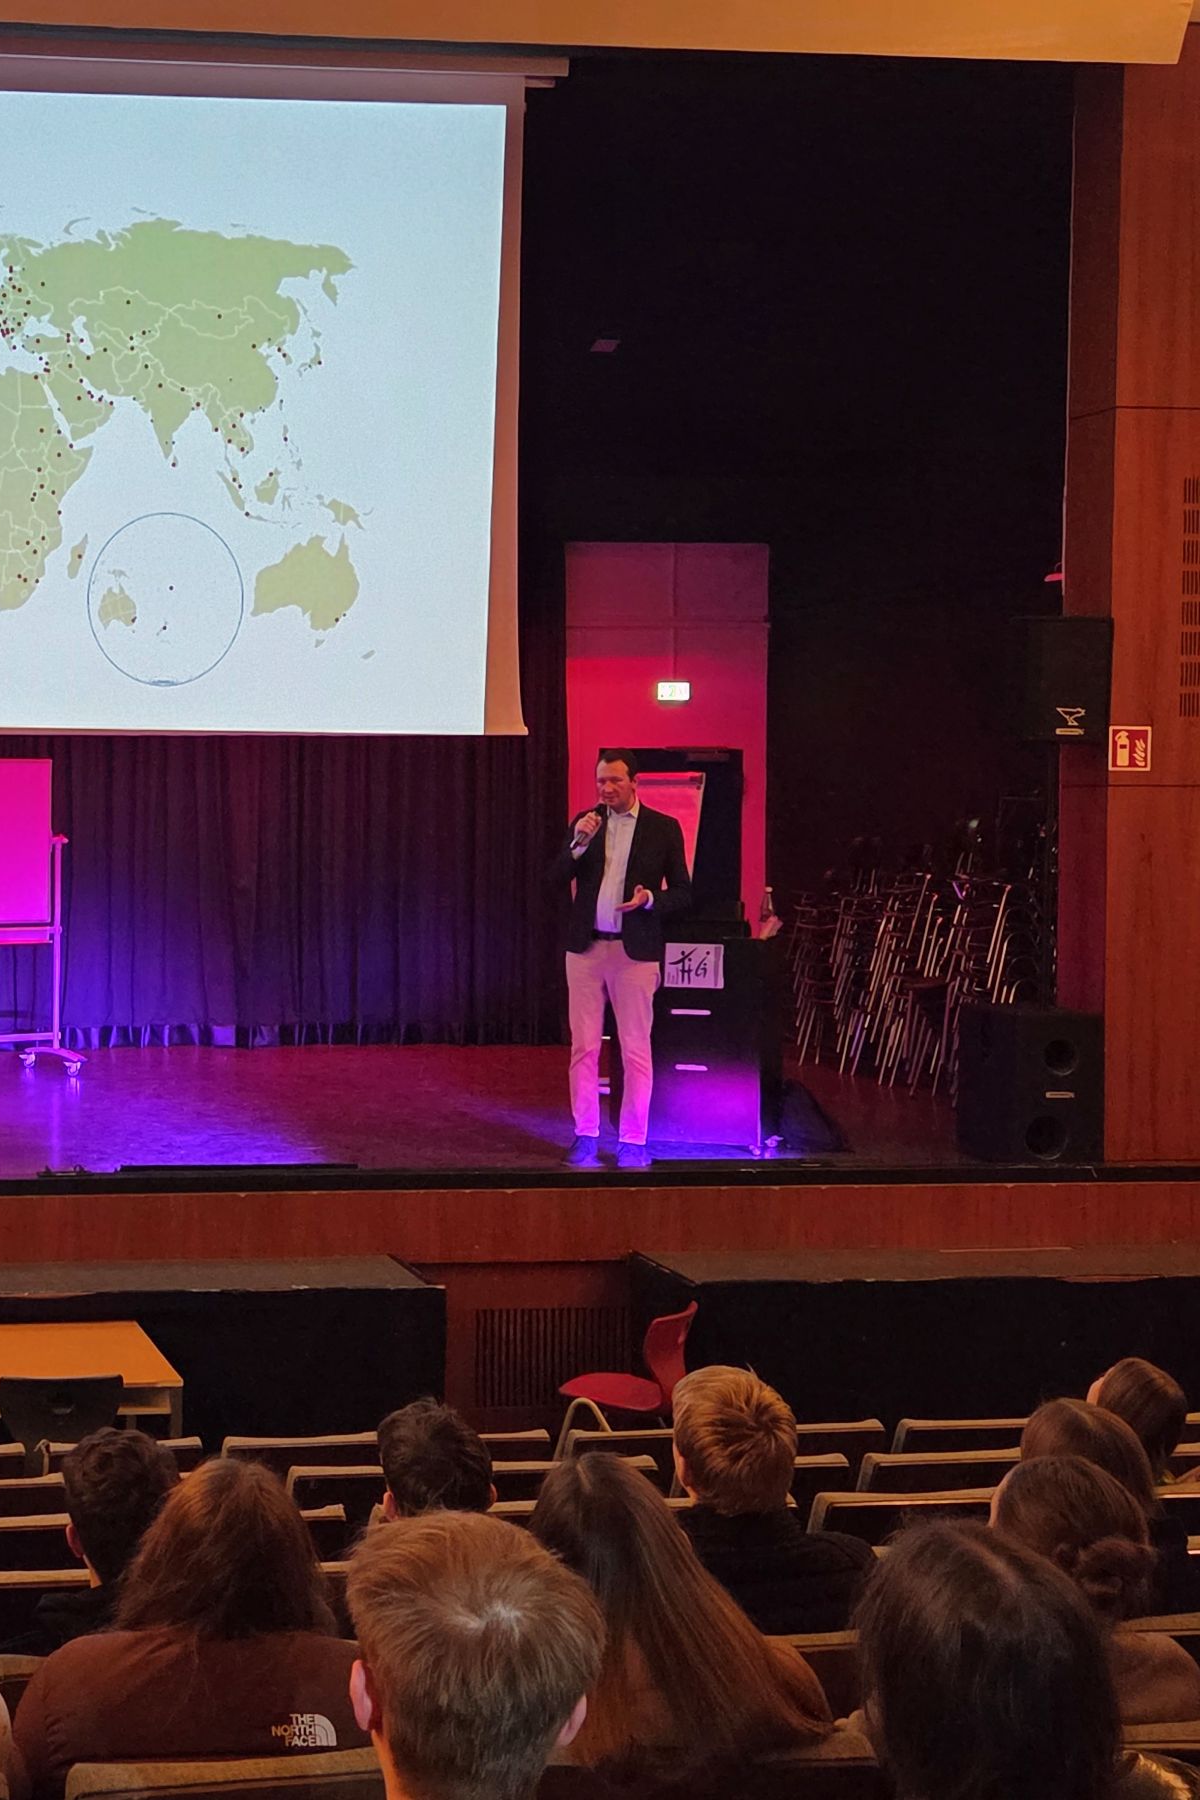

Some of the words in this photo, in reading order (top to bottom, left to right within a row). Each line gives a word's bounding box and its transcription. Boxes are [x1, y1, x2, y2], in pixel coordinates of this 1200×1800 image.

[289, 1713, 315, 1725] THE
[271, 1724, 315, 1737] NORTH
[285, 1735, 317, 1747] FACE
